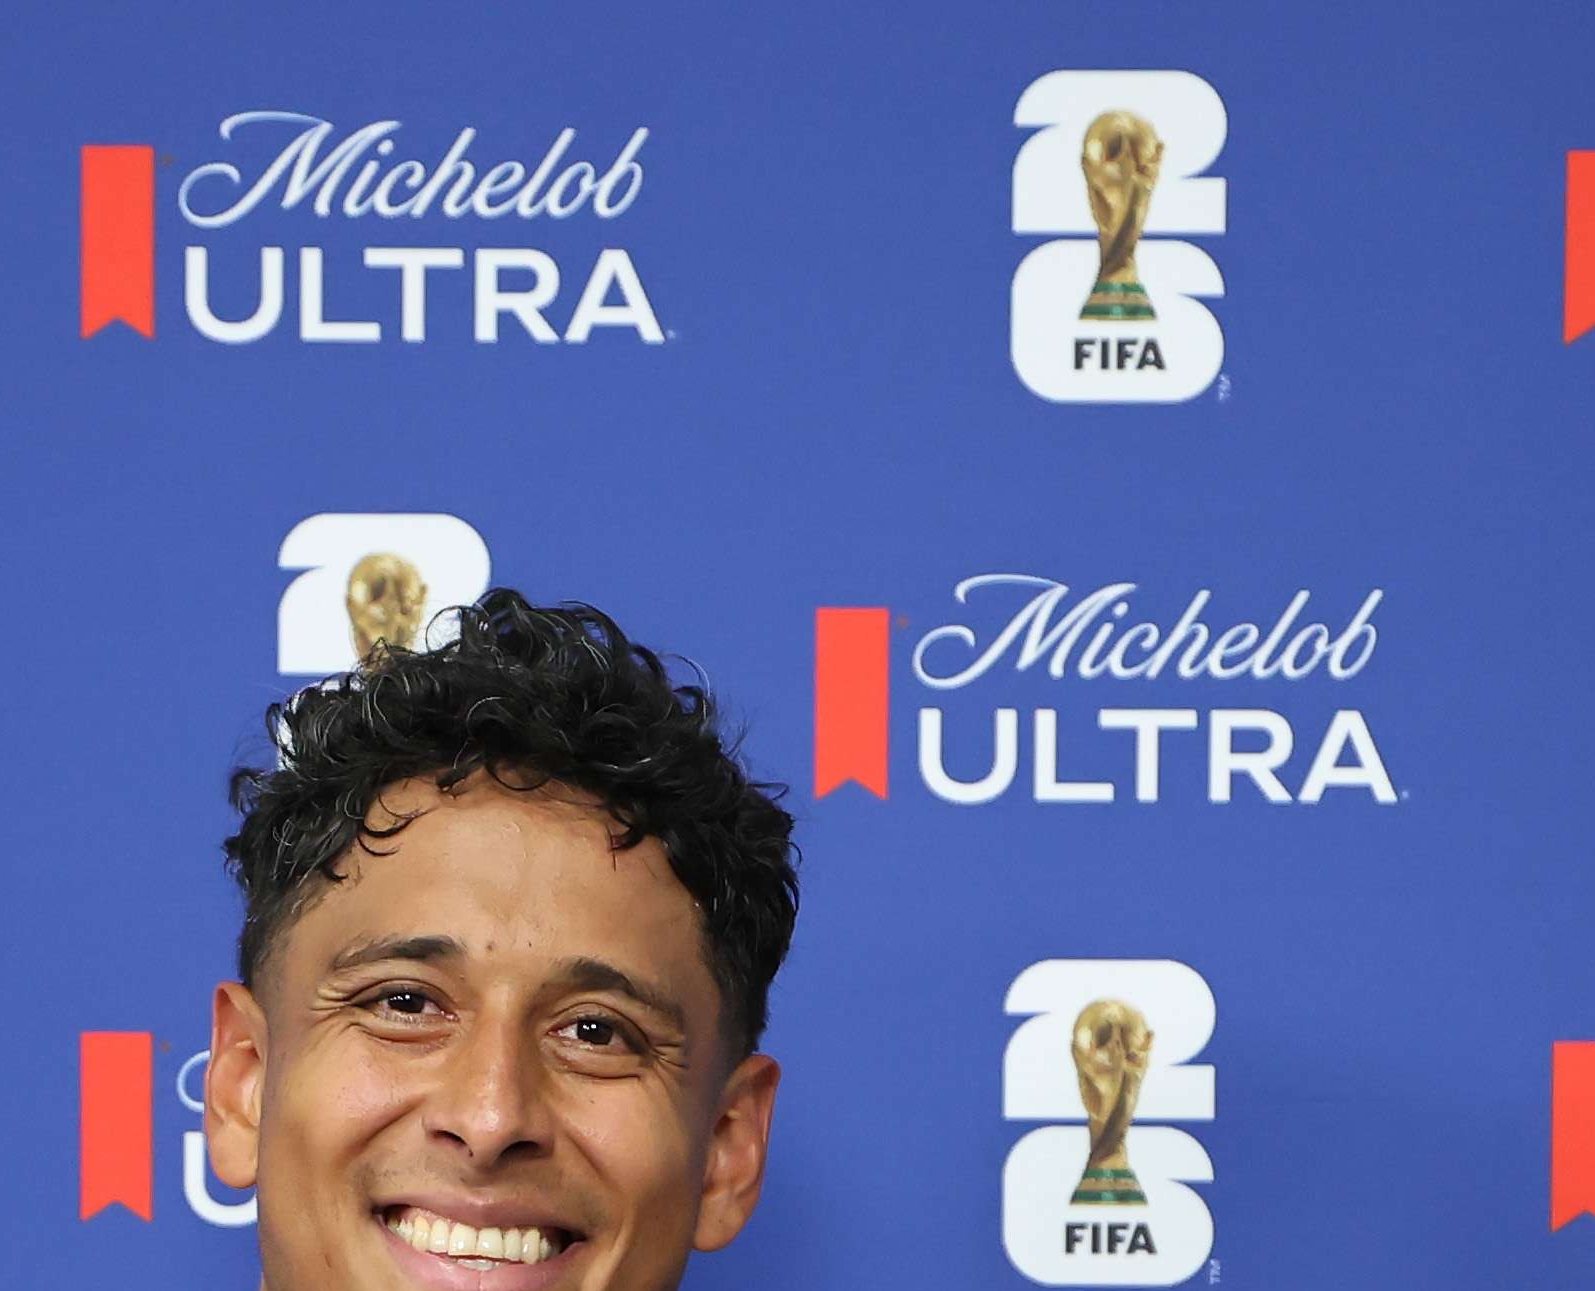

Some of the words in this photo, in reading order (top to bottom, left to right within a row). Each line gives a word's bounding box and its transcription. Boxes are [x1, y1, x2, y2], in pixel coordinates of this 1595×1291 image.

[179, 112, 648, 227] Michelob
[185, 246, 665, 344] ULTRA
[1074, 339, 1165, 370] FIFA
[913, 574, 1382, 689] Michelob
[919, 708, 1397, 804] ULTRA
[1065, 1223, 1156, 1254] FIFA
